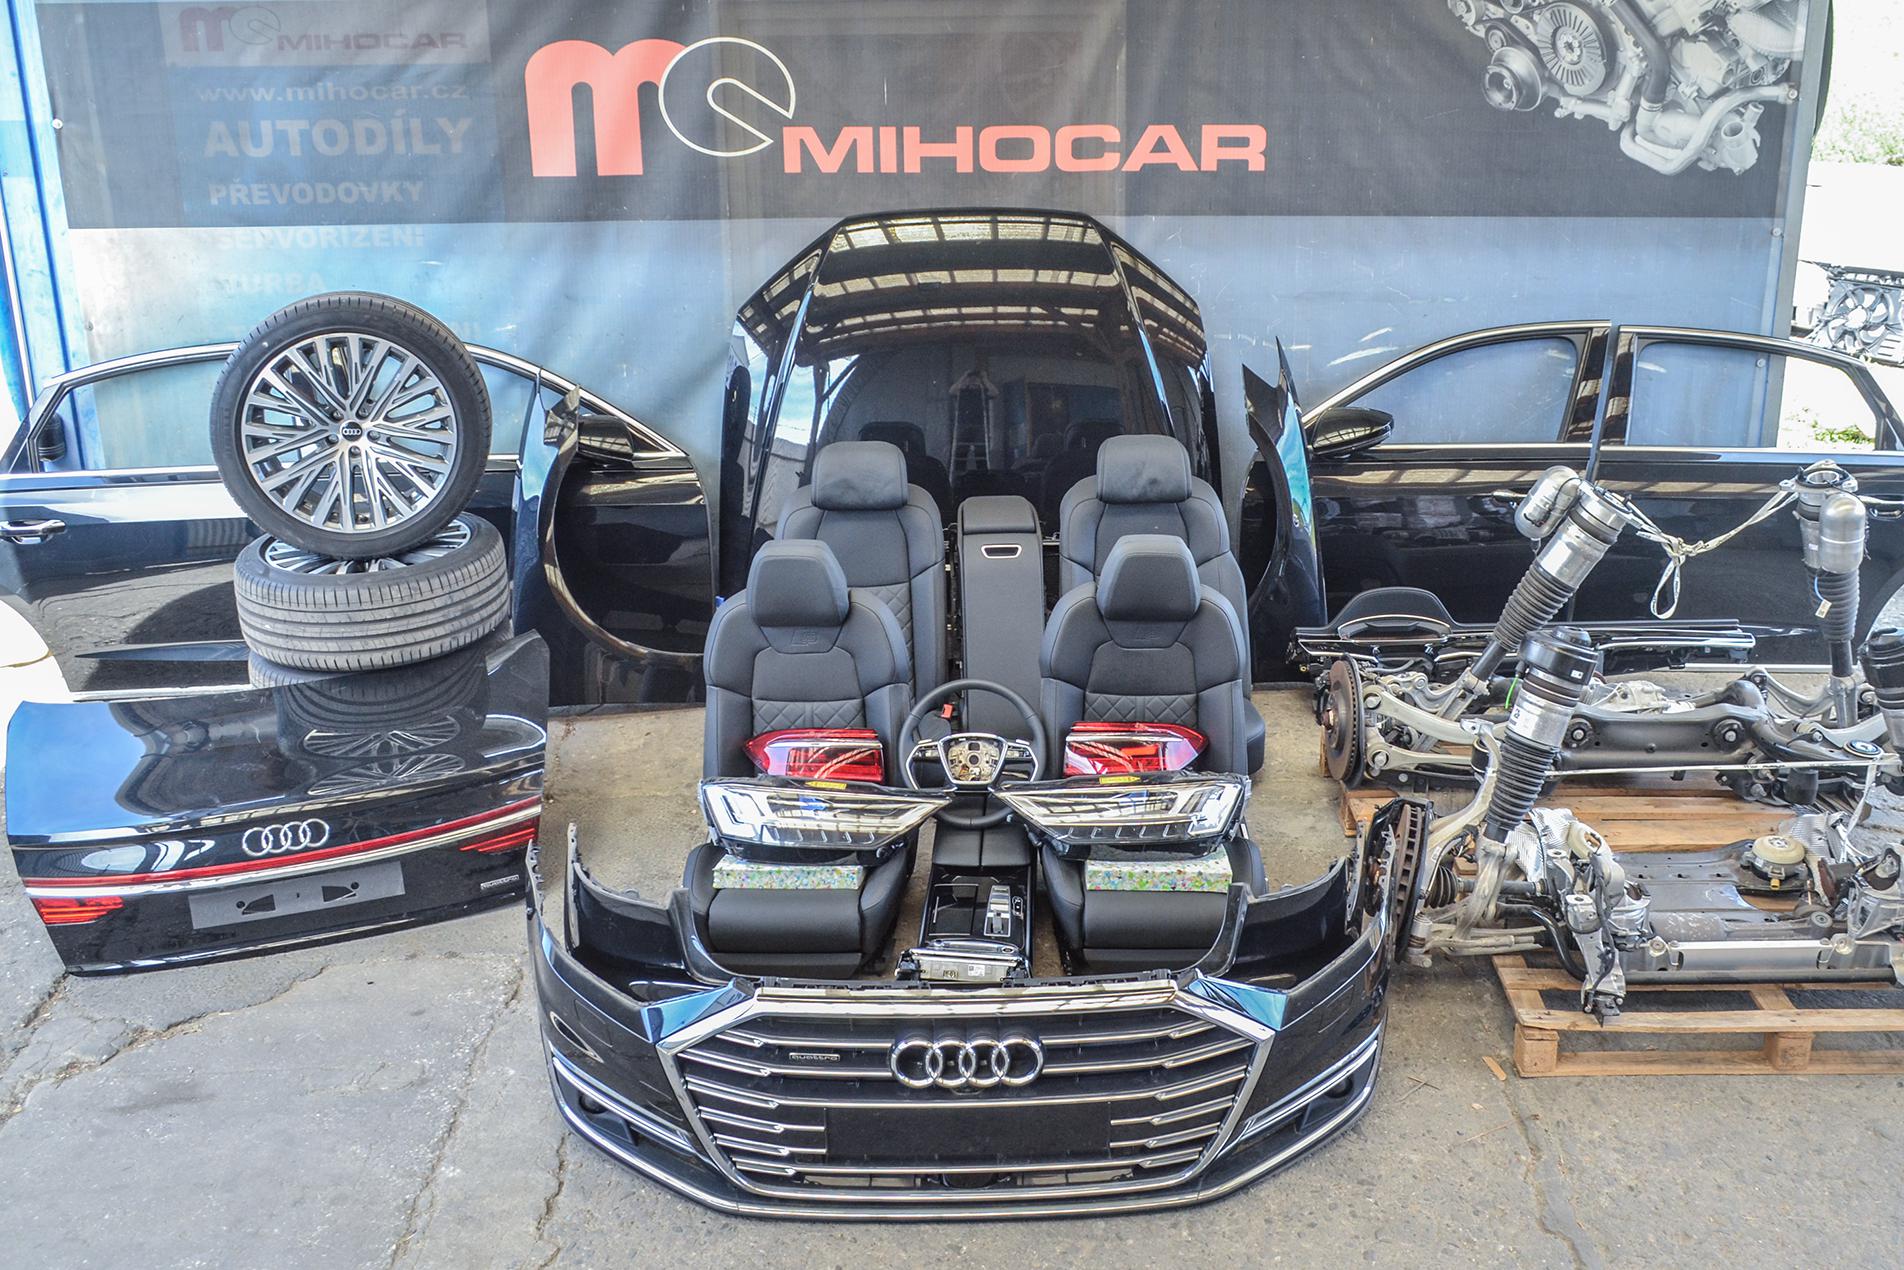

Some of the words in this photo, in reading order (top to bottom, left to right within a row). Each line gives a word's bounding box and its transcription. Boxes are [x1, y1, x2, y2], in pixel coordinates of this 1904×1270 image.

[277, 32, 468, 51] MIHOCAR
[198, 80, 468, 102] www.mihocar.cz
[203, 108, 473, 158] AUTODÍLY
[784, 124, 1268, 174] MIHOCAR
[207, 178, 425, 206] PŘEVODOVKY
